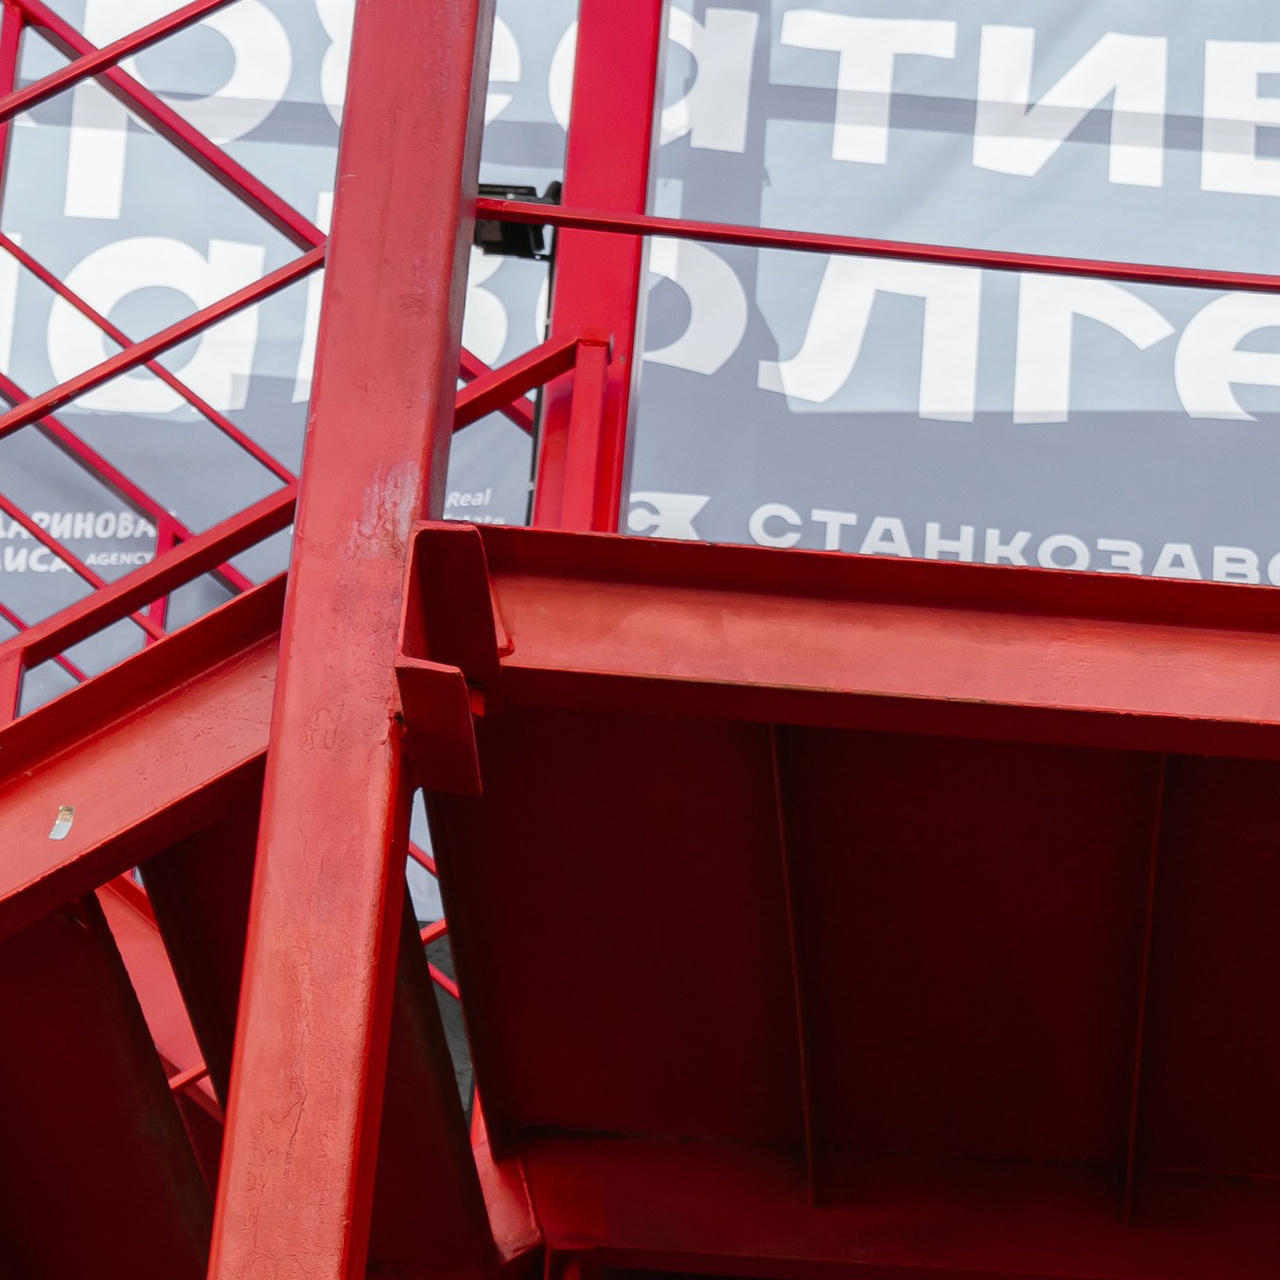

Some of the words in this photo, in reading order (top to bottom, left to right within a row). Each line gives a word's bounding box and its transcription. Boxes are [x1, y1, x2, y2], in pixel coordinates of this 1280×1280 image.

[446, 488, 492, 508] Real
[0, 511, 157, 539] АРИНОВА
[0, 546, 73, 573] ИСА
[84, 552, 155, 566] AGENCY
